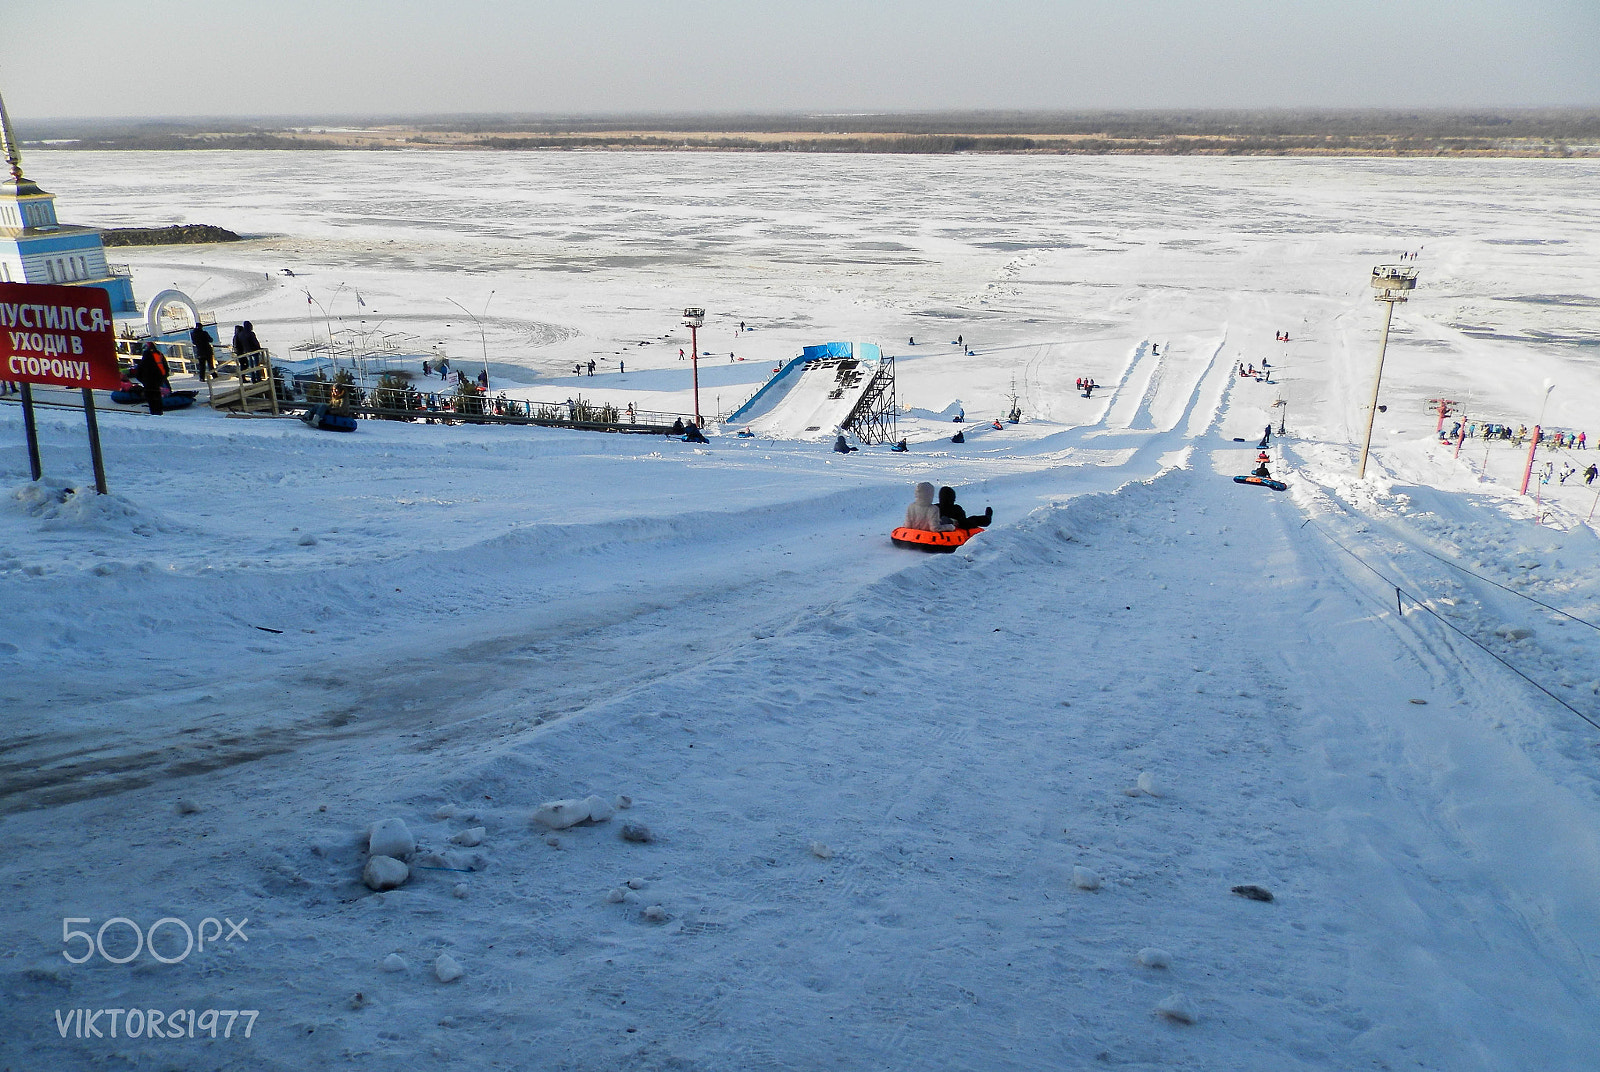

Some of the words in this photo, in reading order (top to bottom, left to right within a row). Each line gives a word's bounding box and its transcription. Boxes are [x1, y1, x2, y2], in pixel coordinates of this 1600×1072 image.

[8, 332, 67, 356] УХОДИ
[71, 335, 83, 354] В
[8, 356, 91, 381] СТОРОНУ!
